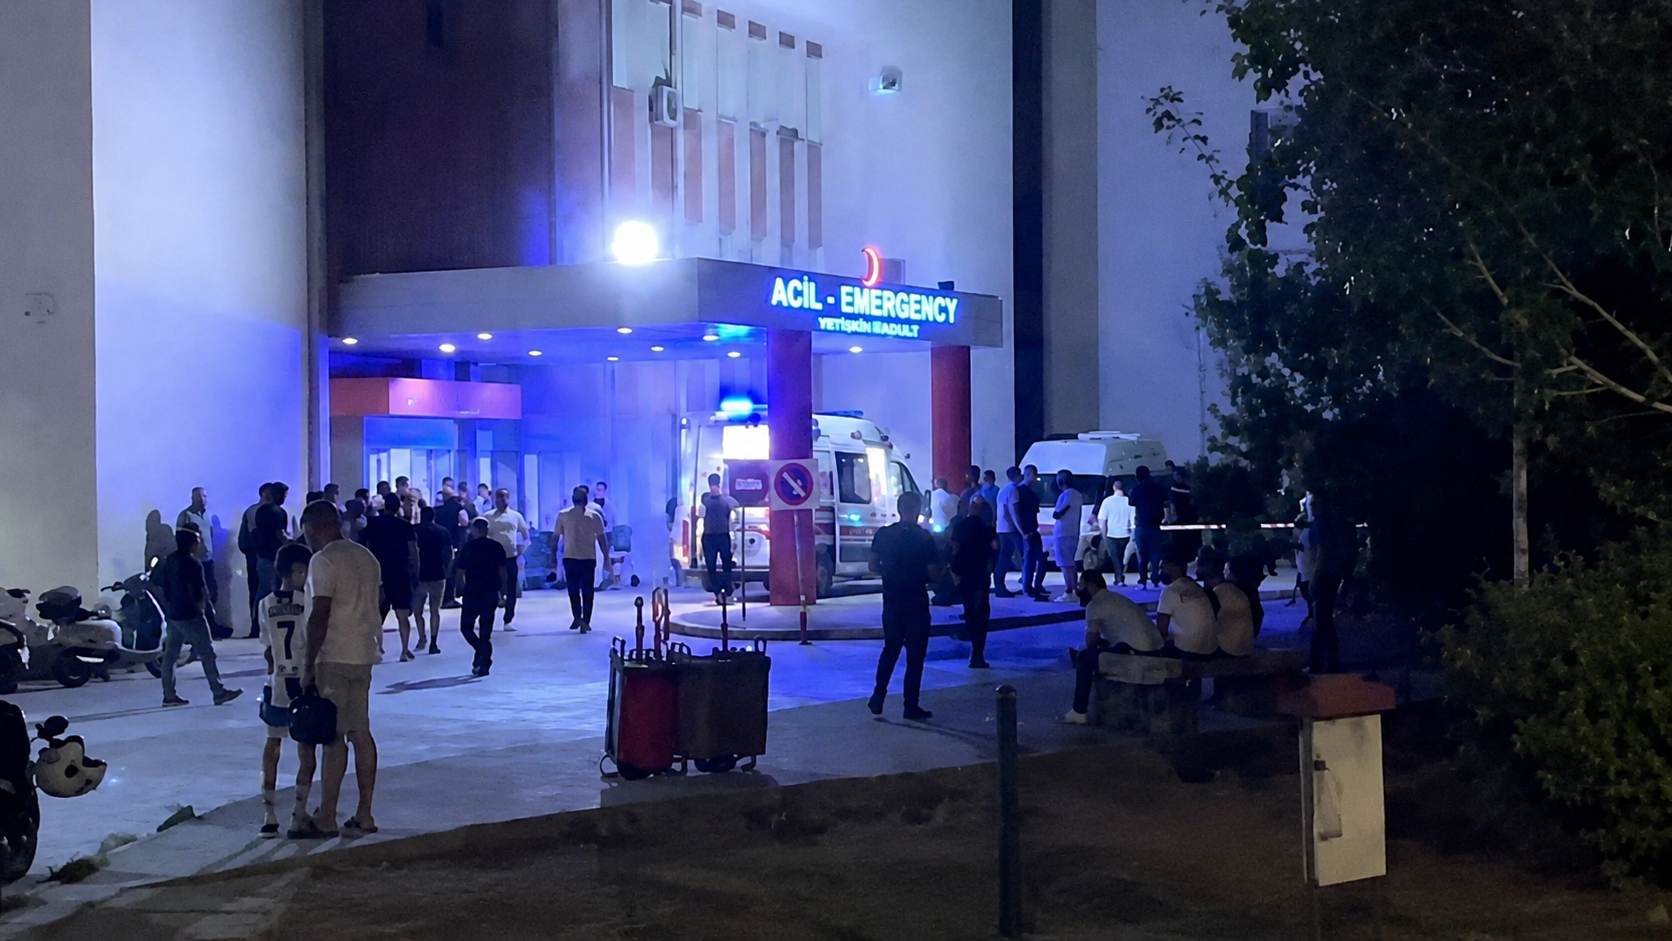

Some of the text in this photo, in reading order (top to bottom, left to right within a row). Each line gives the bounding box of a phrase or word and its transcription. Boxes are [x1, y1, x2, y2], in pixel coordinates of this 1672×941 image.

[771, 275, 823, 310] ACİL
[840, 285, 959, 324] EMERGENCY
[818, 316, 872, 334] YETİŞKİN
[880, 322, 920, 338] ADULT
[277, 620, 295, 660] 7
